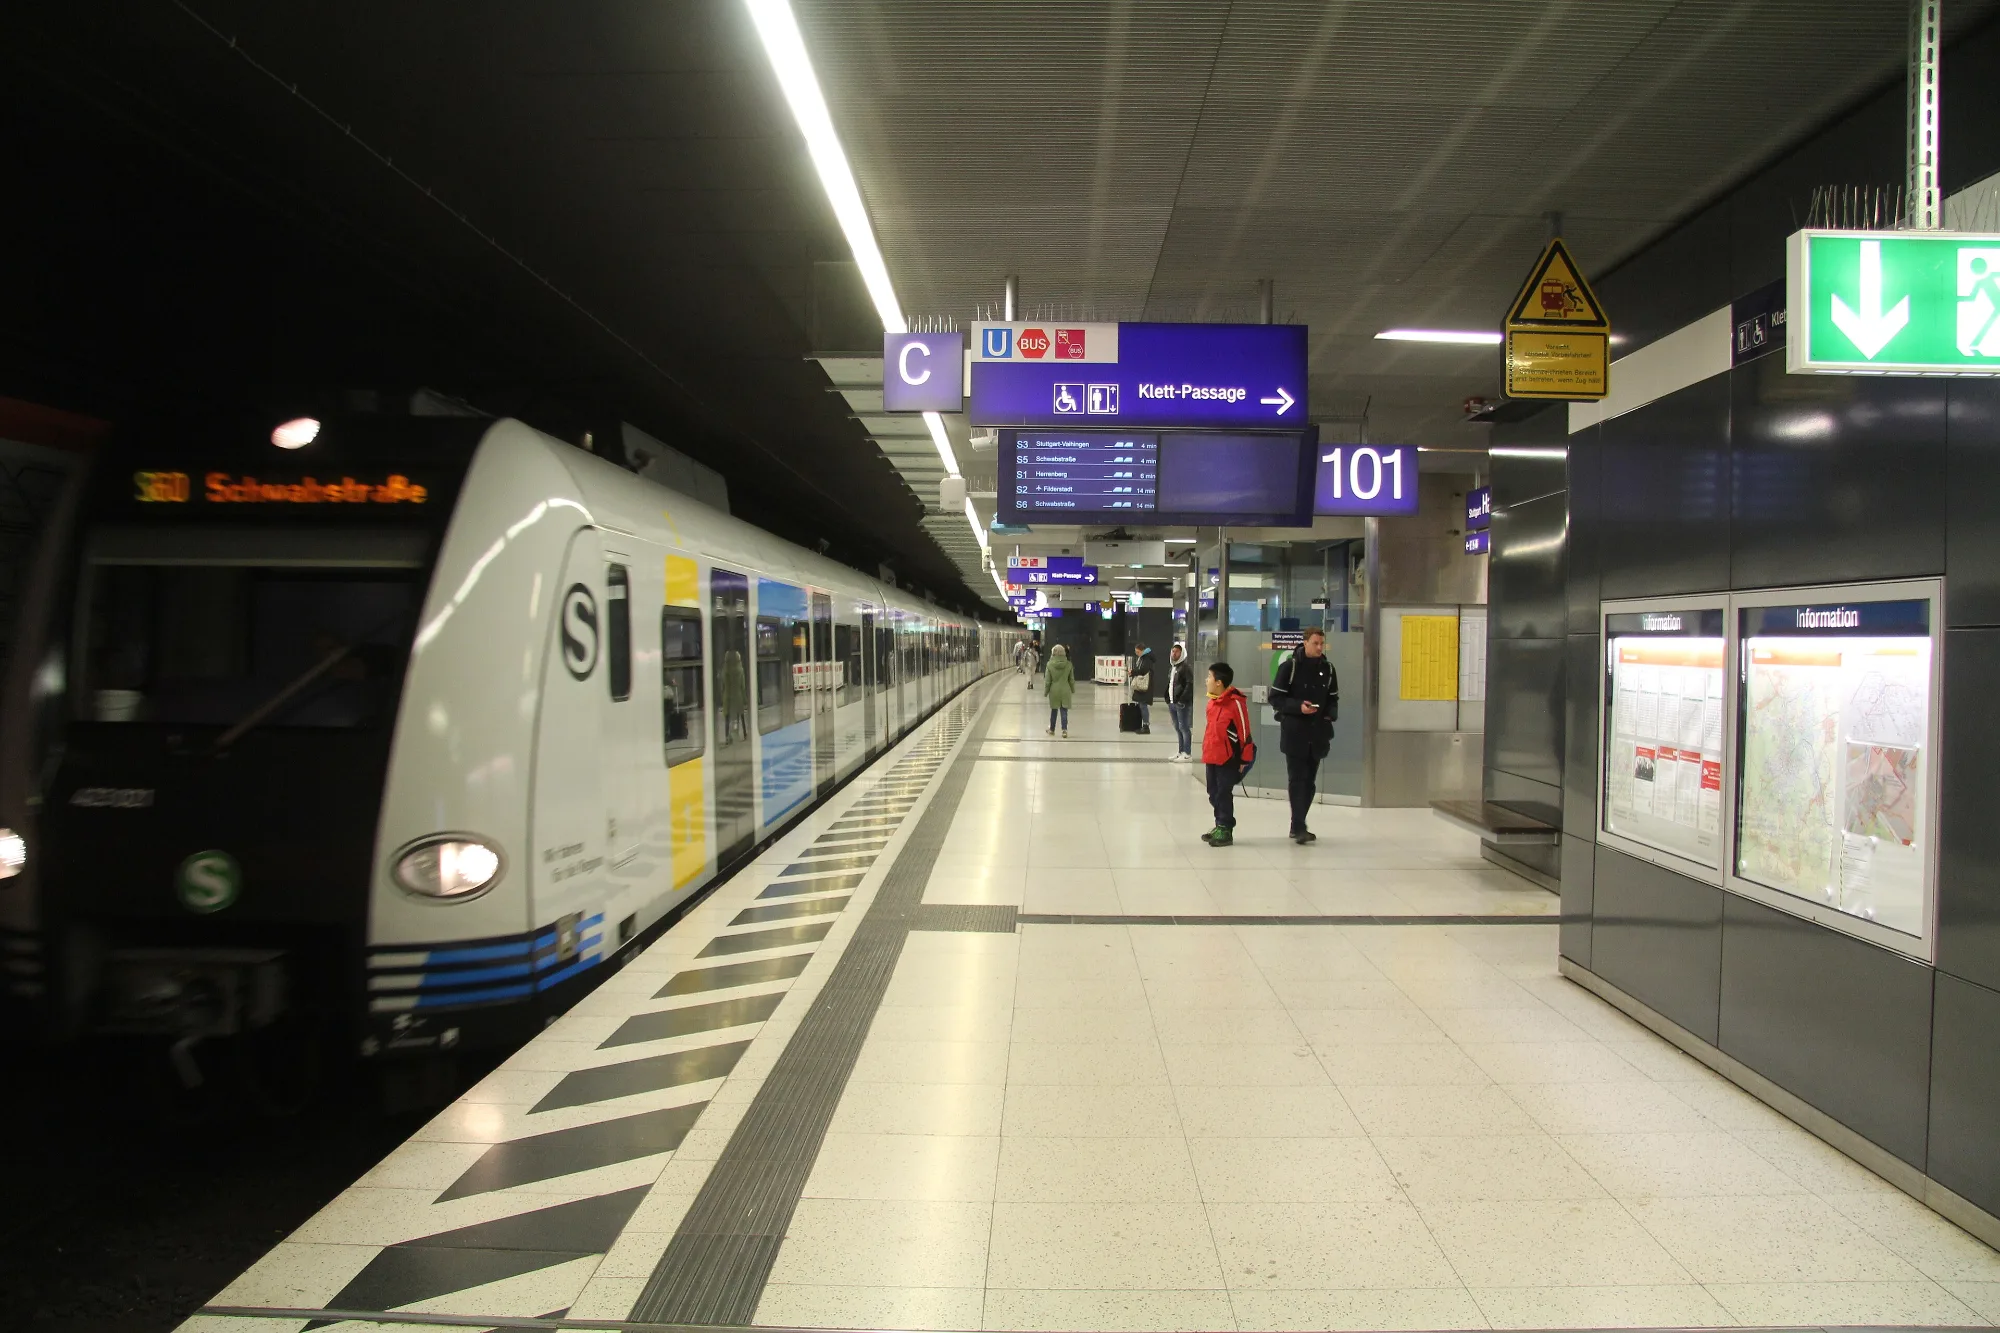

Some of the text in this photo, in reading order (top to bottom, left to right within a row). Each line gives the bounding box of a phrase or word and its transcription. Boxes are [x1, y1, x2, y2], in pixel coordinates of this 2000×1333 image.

[987, 330, 1008, 356] U
[1020, 338, 1047, 350] BUS
[898, 342, 931, 385] C
[1138, 383, 1246, 401] Klett-Passage
[1016, 440, 1029, 449] S3
[1036, 440, 1089, 448] Stuttgart-Vaihingen
[1016, 455, 1029, 464] S5
[1016, 470, 1028, 479] S1
[1322, 448, 1402, 499] 101
[1016, 485, 1028, 494] S2
[1016, 500, 1028, 509] S6
[1085, 603, 1092, 611] B
[1643, 615, 1680, 631] Information
[1796, 607, 1859, 629] Information
[564, 590, 596, 675] S
[186, 857, 230, 906] S
